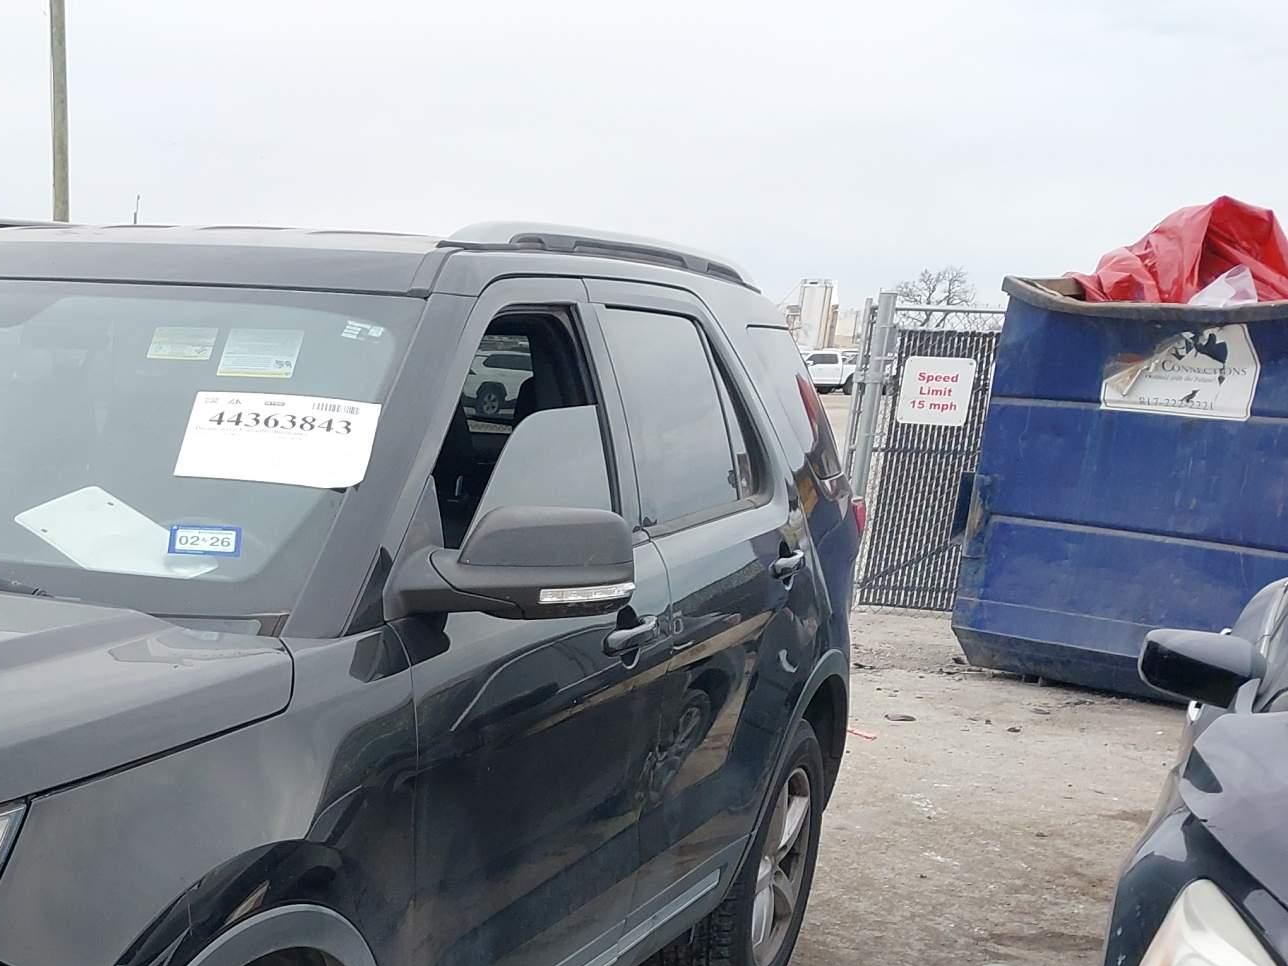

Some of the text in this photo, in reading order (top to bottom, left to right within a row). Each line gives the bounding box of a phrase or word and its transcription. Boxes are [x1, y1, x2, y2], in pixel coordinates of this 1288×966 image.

[918, 372, 959, 384] Speed
[919, 386, 952, 397] Limit
[910, 400, 957, 412] 15 mph
[209, 411, 353, 435] 44363843
[179, 536, 231, 548] 02 26
